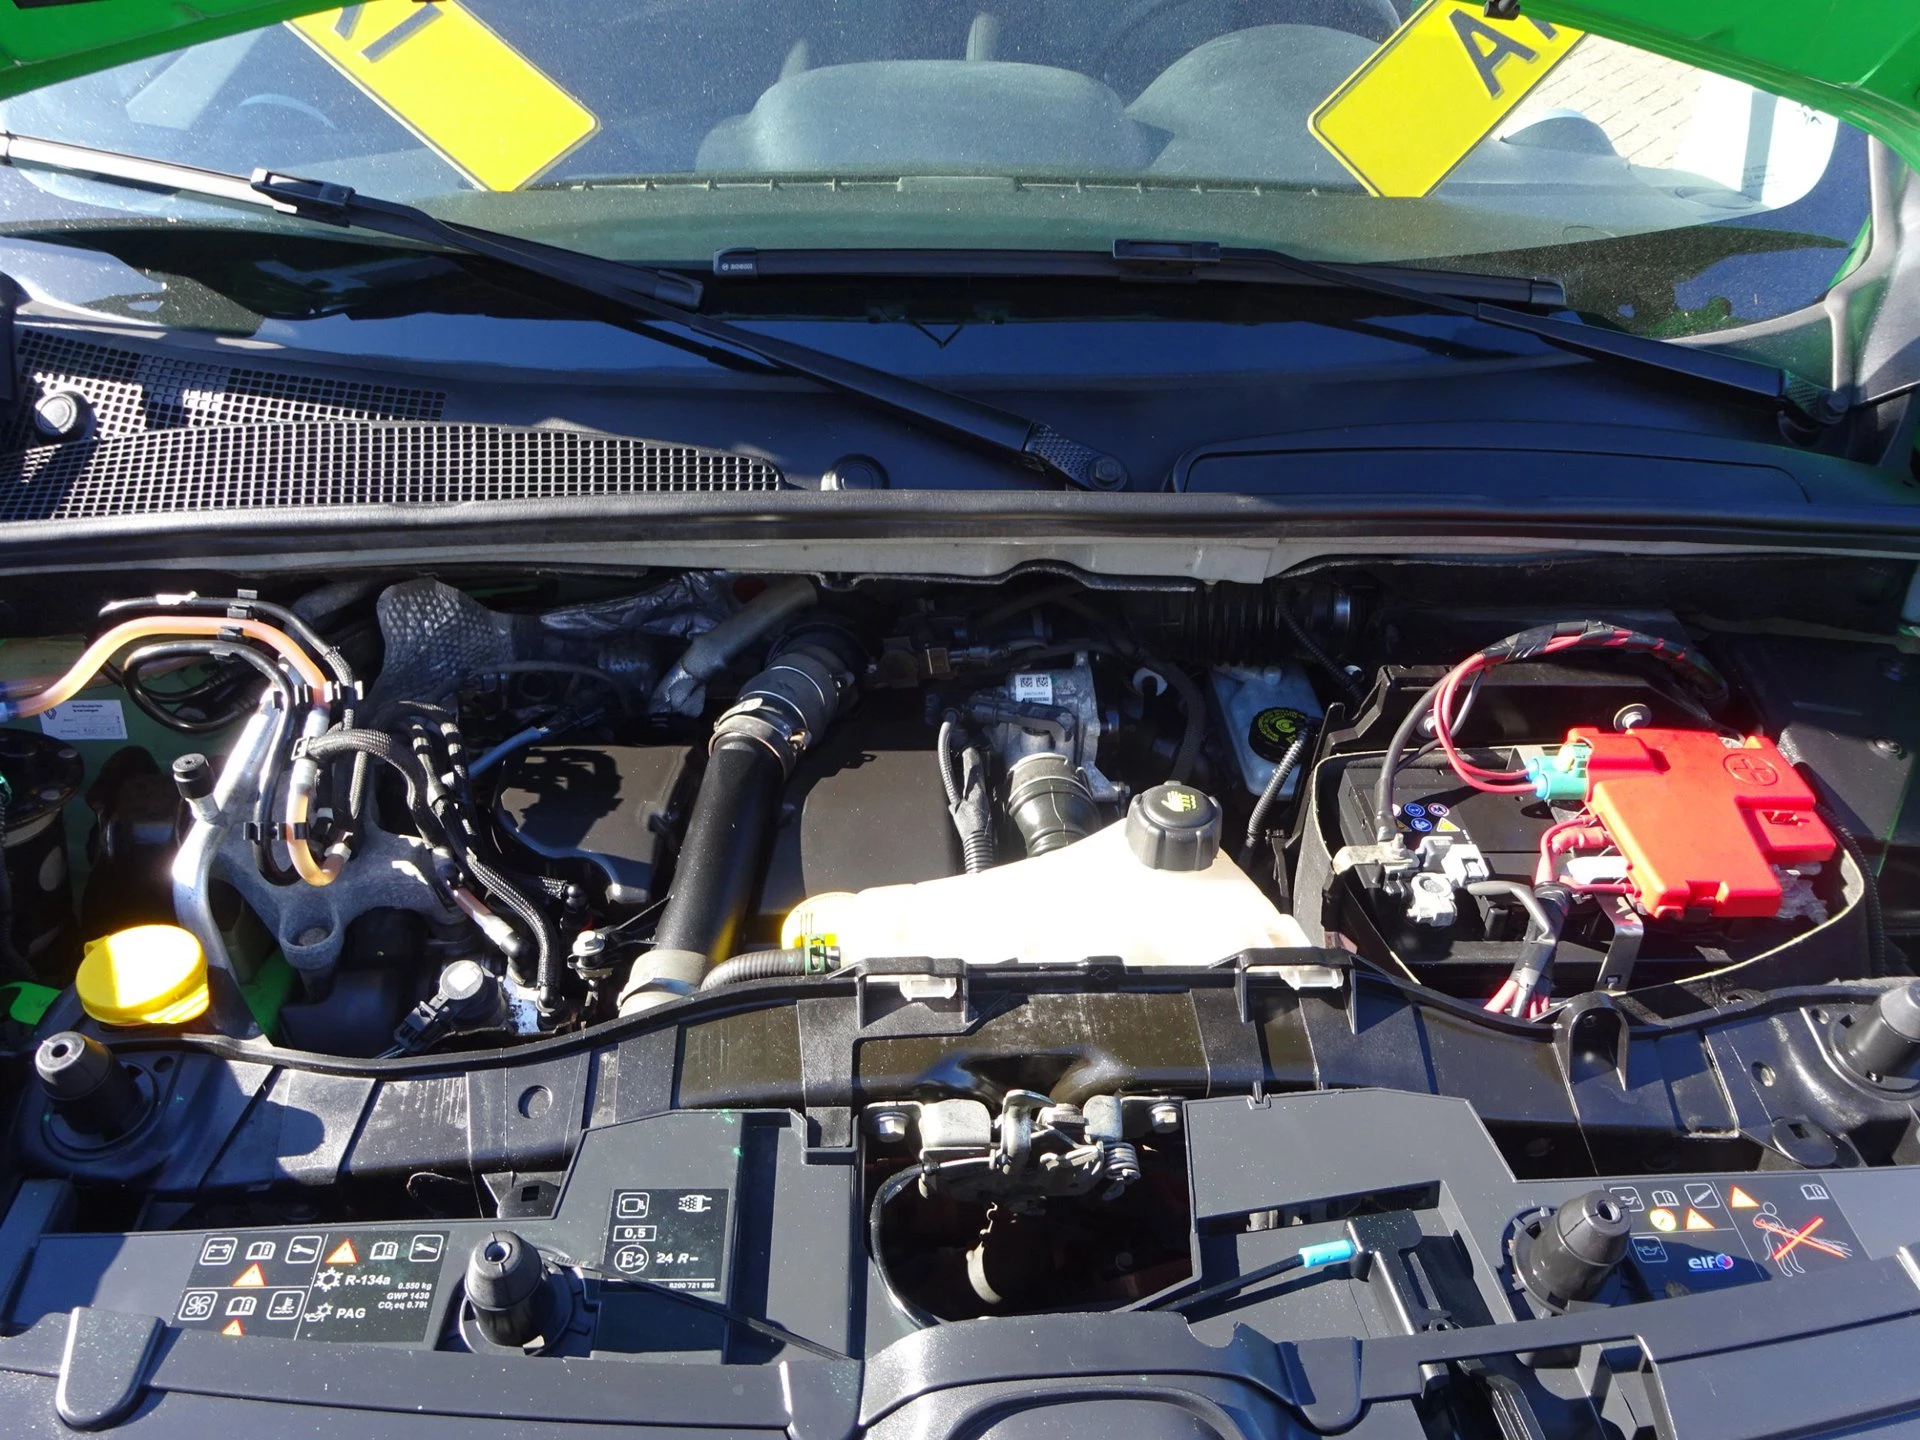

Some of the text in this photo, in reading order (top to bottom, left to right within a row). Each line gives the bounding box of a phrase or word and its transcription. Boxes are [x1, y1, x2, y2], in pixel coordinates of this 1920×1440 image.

[624, 1228, 646, 1239] 0,5
[656, 1253, 674, 1264] 24
[1688, 1256, 1715, 1269] elf
[345, 1274, 391, 1286] R-134a
[398, 1282, 432, 1291] 0.550 kg
[386, 1292, 430, 1300] GWP 1430
[336, 1307, 366, 1319] PAG
